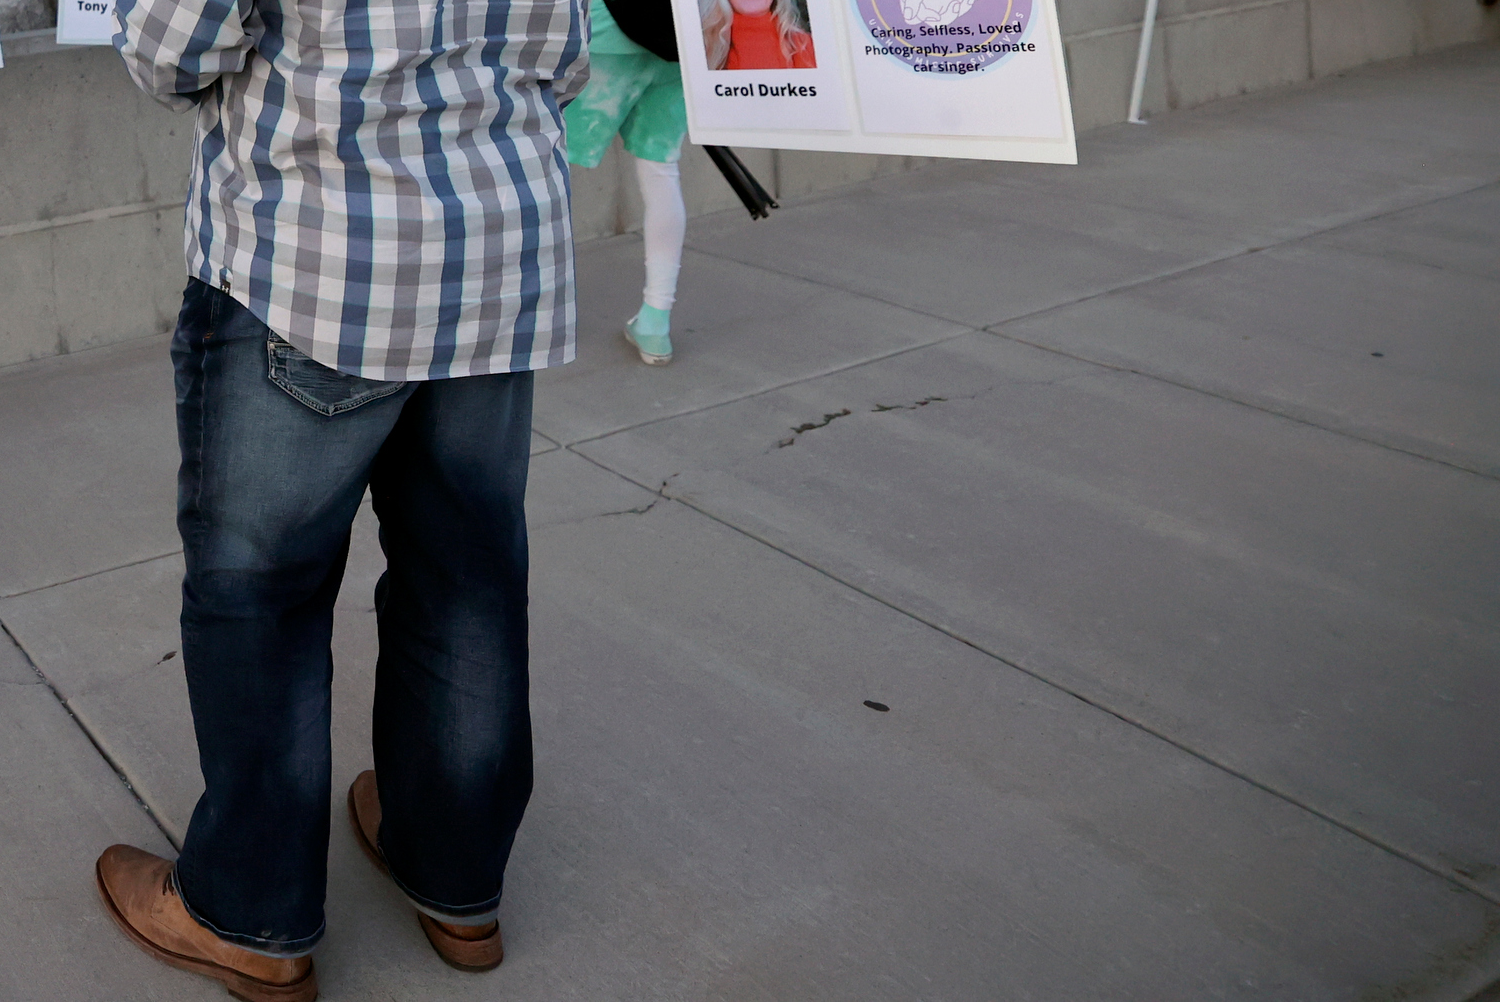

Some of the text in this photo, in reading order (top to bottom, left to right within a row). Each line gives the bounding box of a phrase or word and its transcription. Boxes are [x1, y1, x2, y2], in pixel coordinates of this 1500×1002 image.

[78, 0, 107, 14] Tony
[871, 22, 1021, 39] Caring, Selfless, Loved
[866, 41, 1035, 58] Photography. Passionate
[914, 62, 984, 74] car singer.
[715, 83, 817, 98] Carol Durkes
